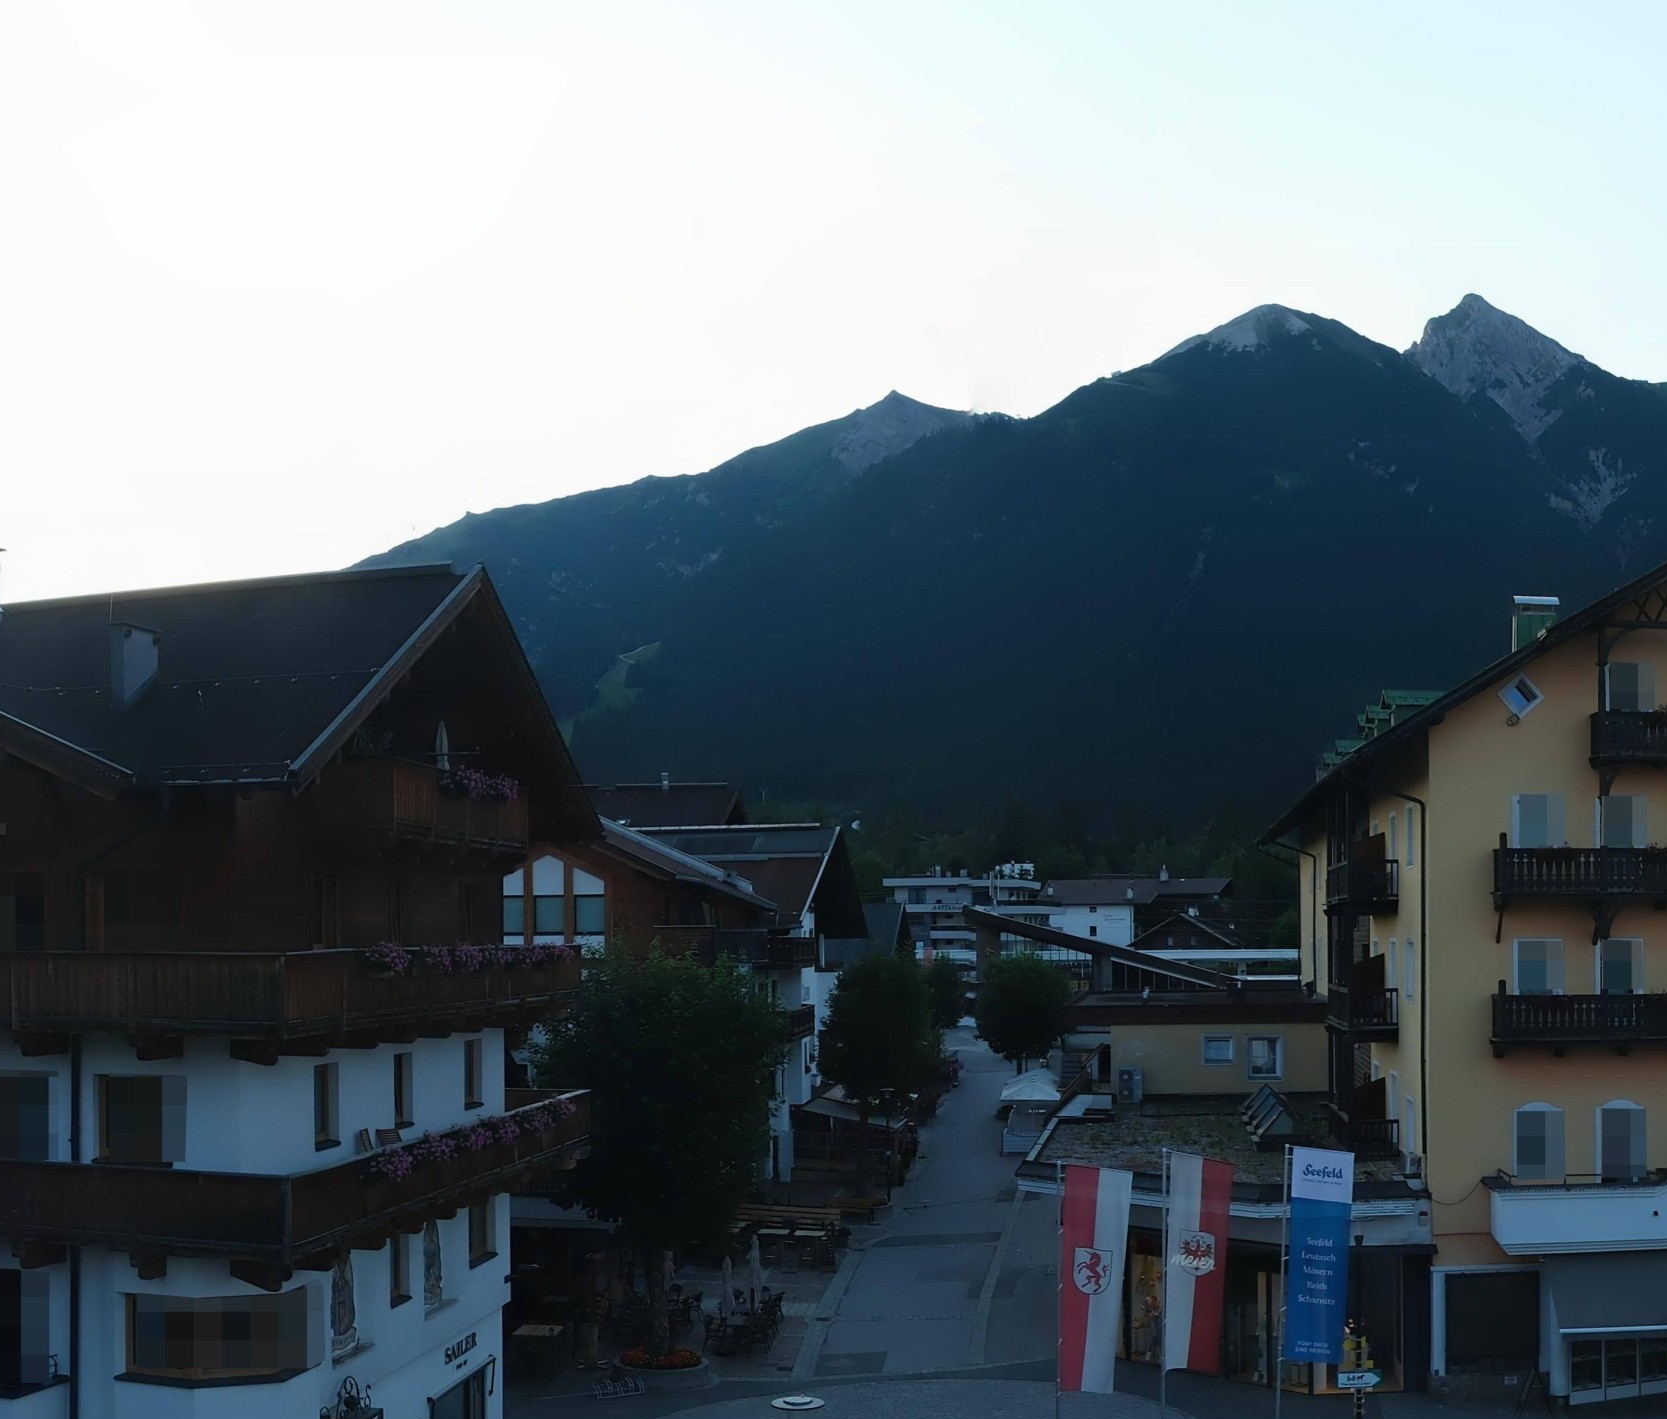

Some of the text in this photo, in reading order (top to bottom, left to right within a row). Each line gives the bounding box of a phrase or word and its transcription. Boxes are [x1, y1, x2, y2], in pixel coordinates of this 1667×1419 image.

[1302, 1163, 1343, 1179] Seefeld
[1306, 1237, 1333, 1247] Seefeld
[1301, 1250, 1336, 1262] Leutasch
[1306, 1281, 1328, 1290] Reith
[1297, 1294, 1336, 1305] Scharnitz
[445, 1331, 477, 1365] SAILER
